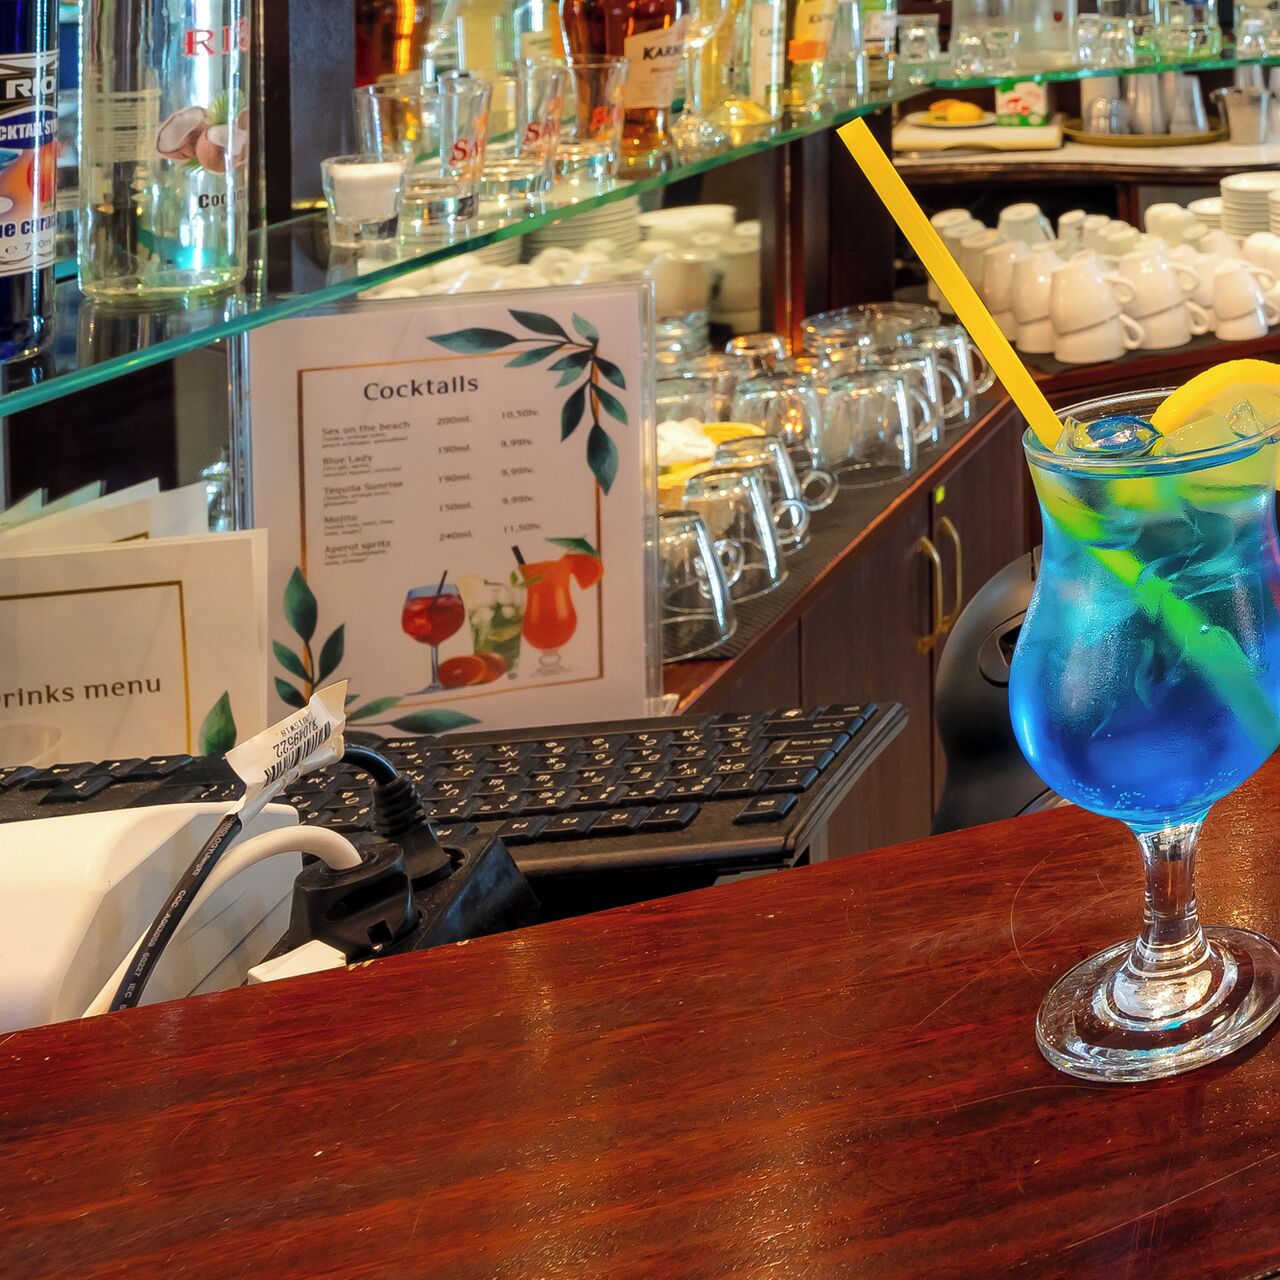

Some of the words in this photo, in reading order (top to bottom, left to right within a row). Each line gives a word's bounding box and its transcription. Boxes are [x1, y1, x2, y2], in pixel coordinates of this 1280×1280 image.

[6, 76, 56, 99] RIO
[363, 375, 479, 401] Cocktails
[0, 684, 75, 708] rinks
[84, 677, 161, 701] menu
